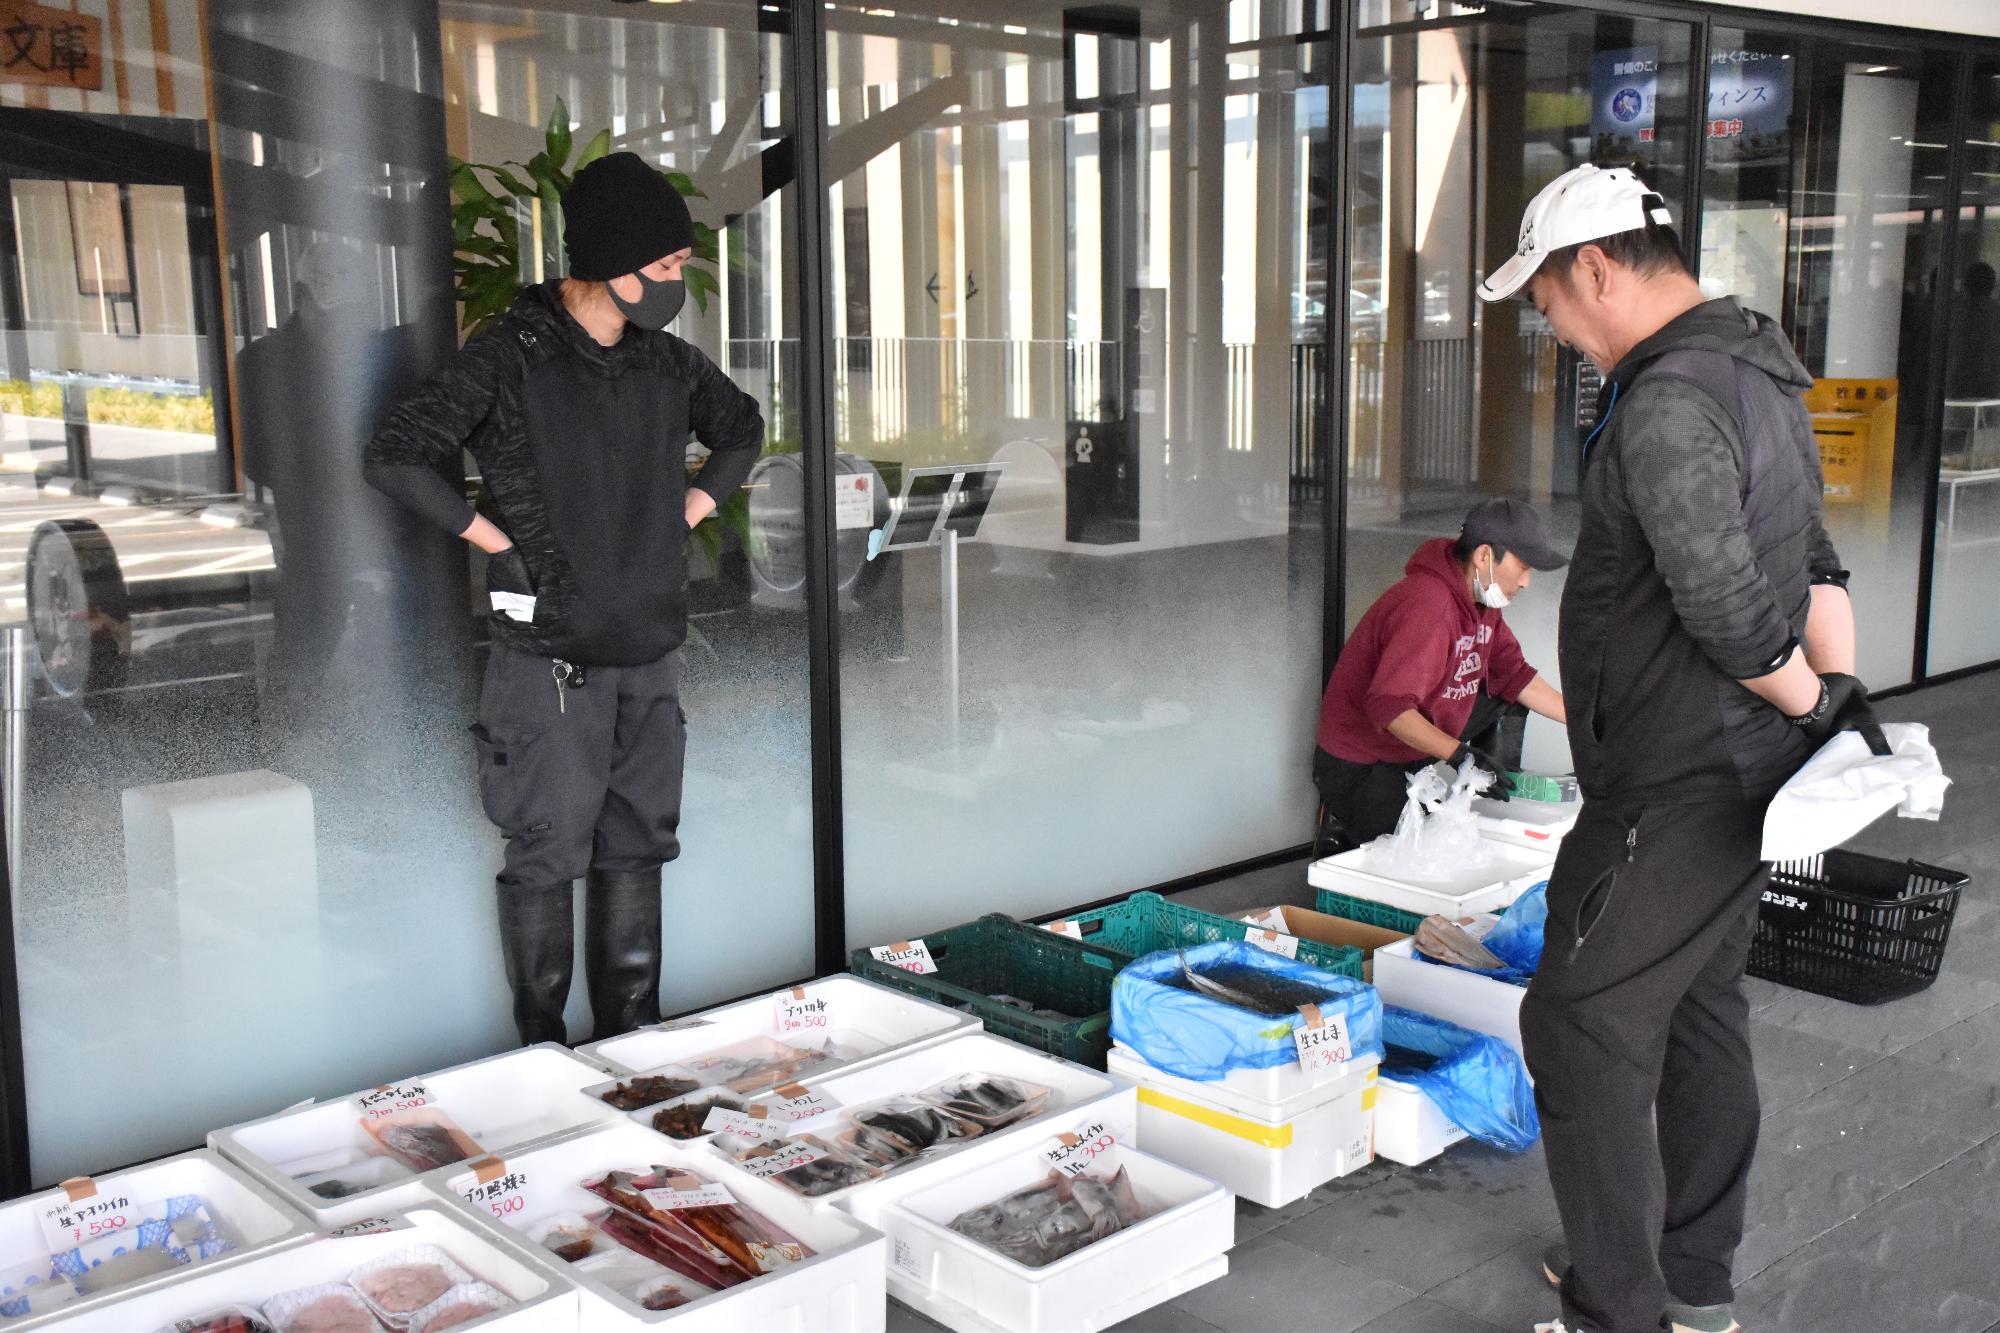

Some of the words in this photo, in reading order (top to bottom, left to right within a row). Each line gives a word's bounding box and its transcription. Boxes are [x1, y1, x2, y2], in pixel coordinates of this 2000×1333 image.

[804, 1015, 827, 1028] 500
[1300, 1023, 1342, 1050] 生さんま
[1321, 1046, 1345, 1066] 300
[395, 1097, 427, 1111] 500
[776, 1095, 822, 1111] いわし
[1080, 1135, 1115, 1160] 300
[491, 1195, 524, 1218] 500
